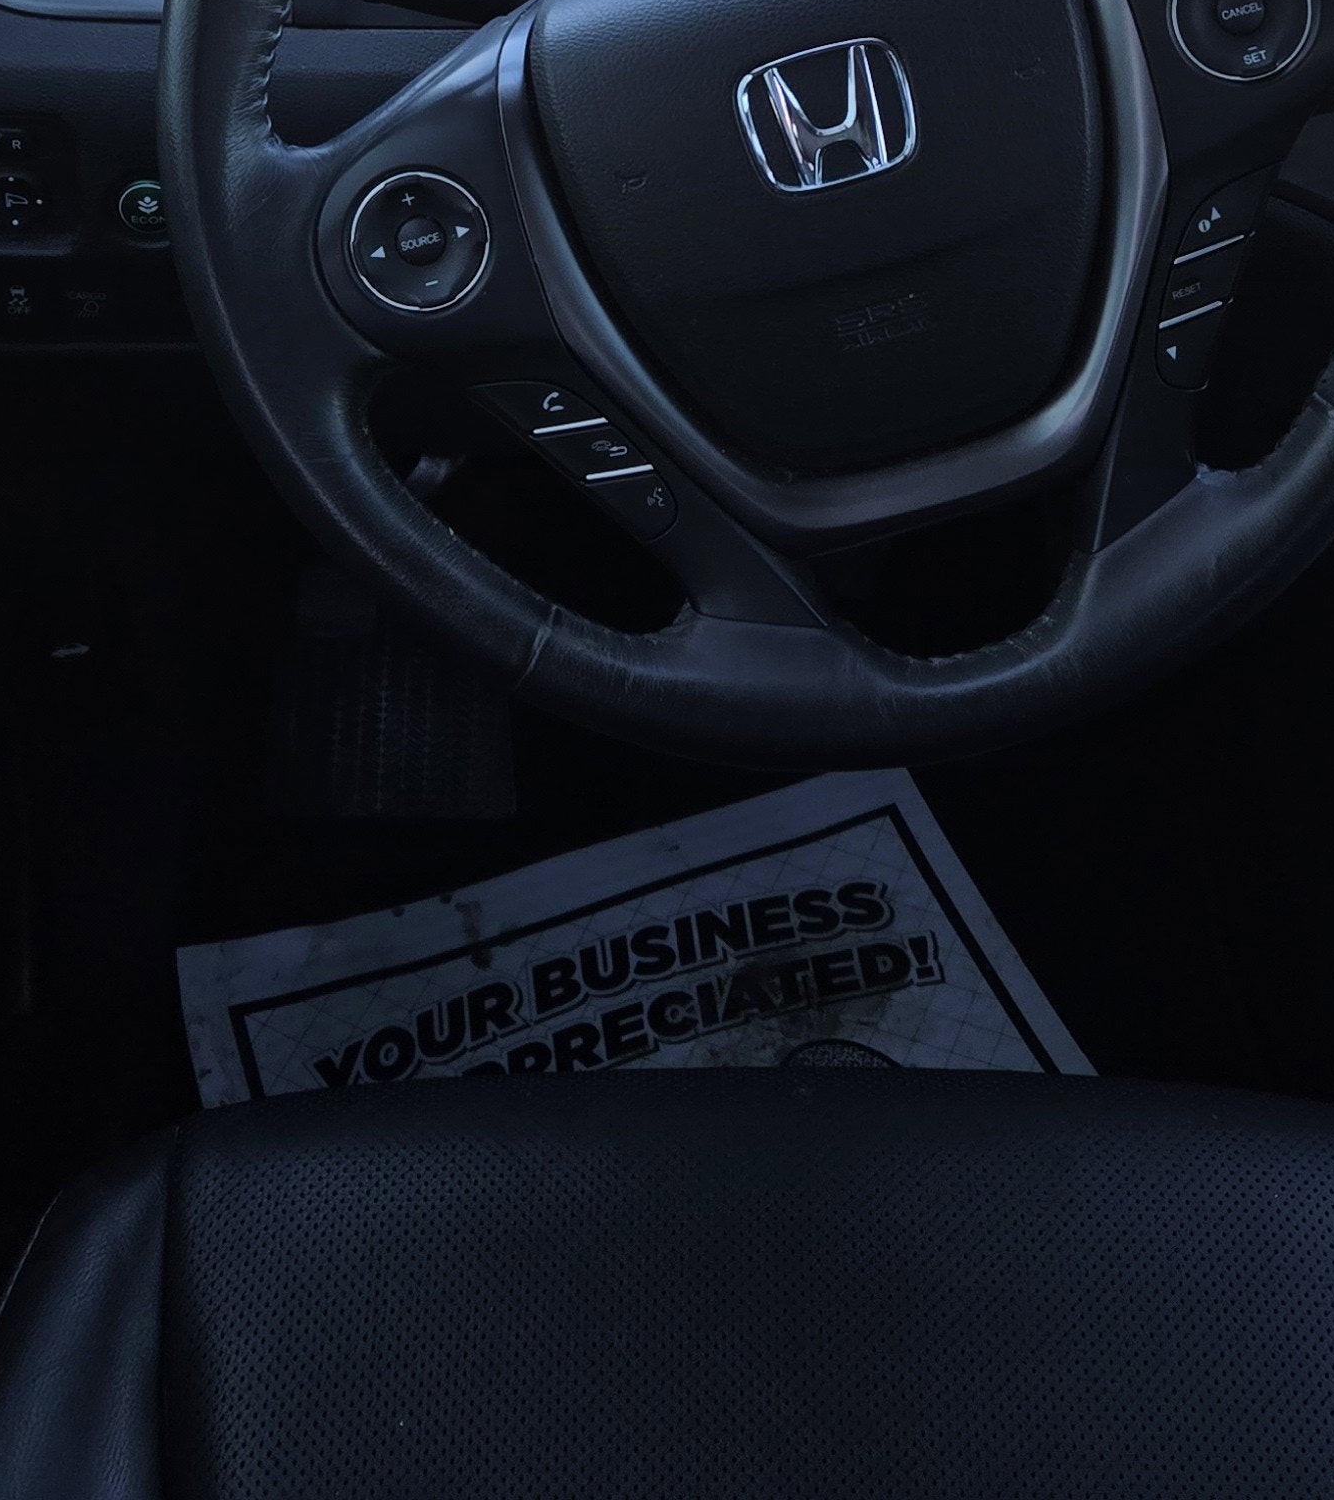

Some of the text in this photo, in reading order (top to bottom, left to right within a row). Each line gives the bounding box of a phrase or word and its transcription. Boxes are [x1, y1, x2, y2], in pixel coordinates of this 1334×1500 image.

[1221, 1, 1263, 21] CANCEL
[1242, 49, 1267, 66] SET
[11, 139, 23, 150] R
[400, 231, 441, 251] SOURCE
[1171, 281, 1202, 300] RESET
[312, 879, 893, 1088] YOUR BUSINESS
